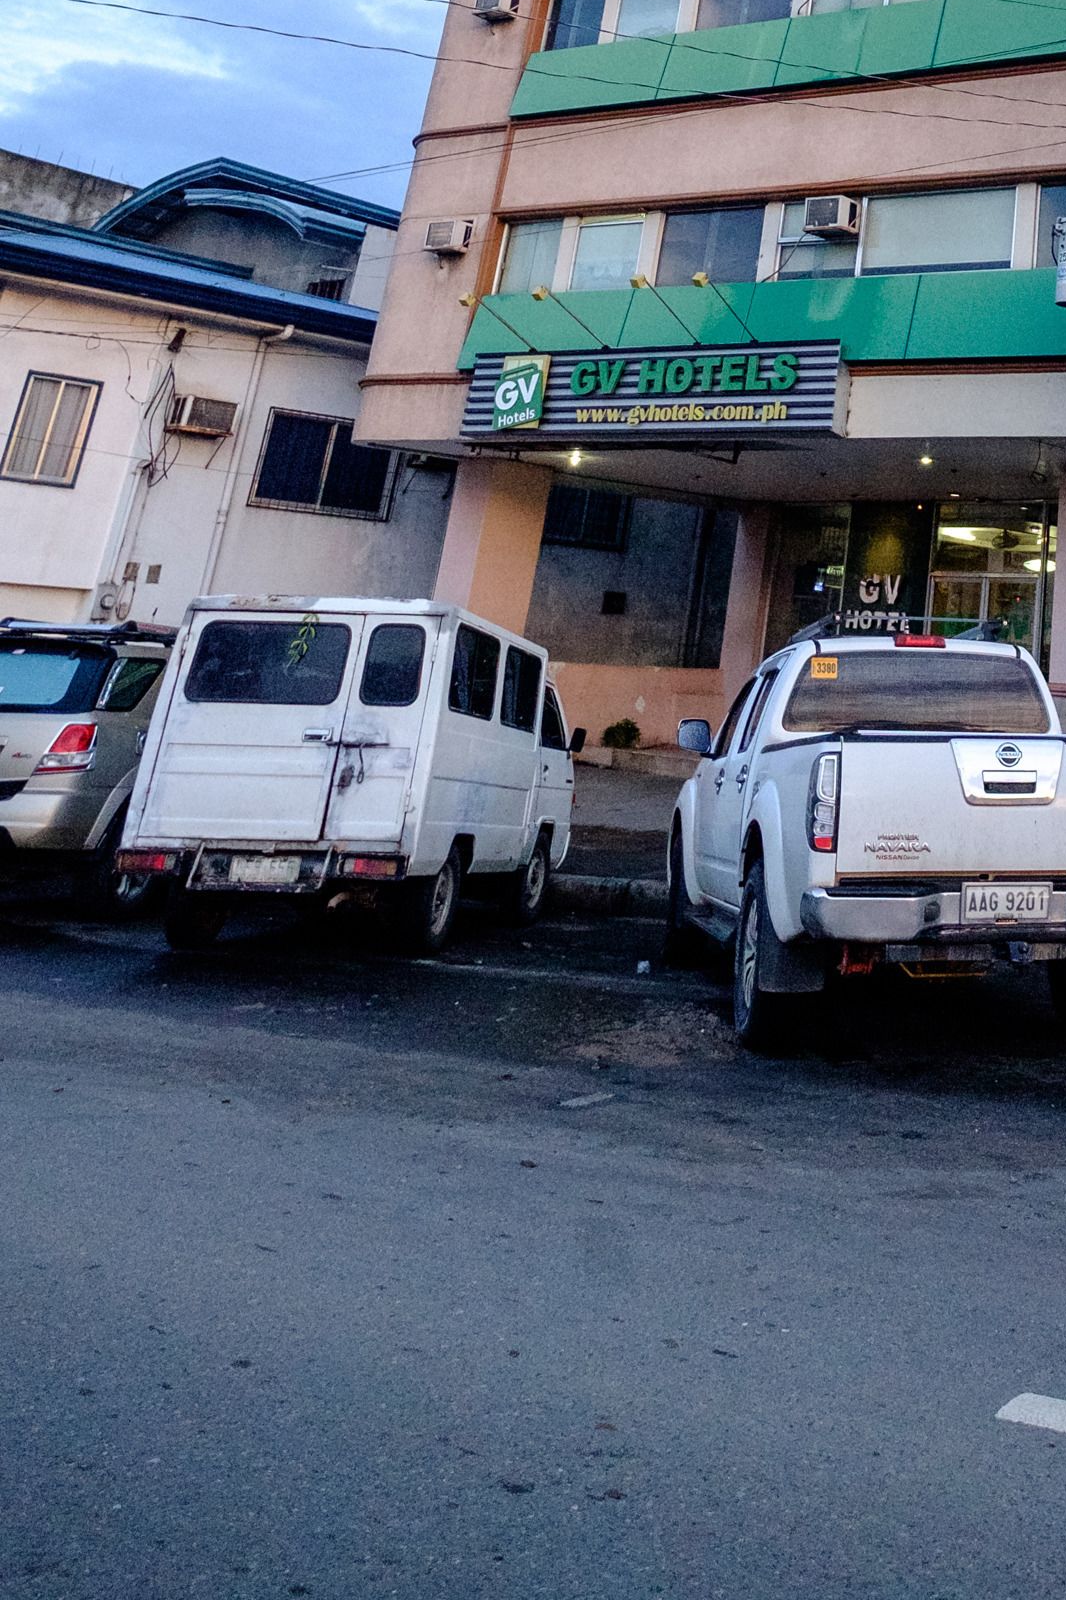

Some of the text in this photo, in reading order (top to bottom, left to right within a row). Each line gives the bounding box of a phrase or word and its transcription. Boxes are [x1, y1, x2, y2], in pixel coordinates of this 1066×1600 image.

[570, 352, 799, 396] GV HOTELS
[495, 373, 539, 410] GV
[498, 408, 536, 428] Hotels
[575, 400, 788, 427] www.gvhotels.com.ph
[859, 574, 901, 604] GV
[816, 662, 836, 674] 3380
[863, 841, 932, 853] NAVARA
[968, 890, 1046, 912] AAG 9201
